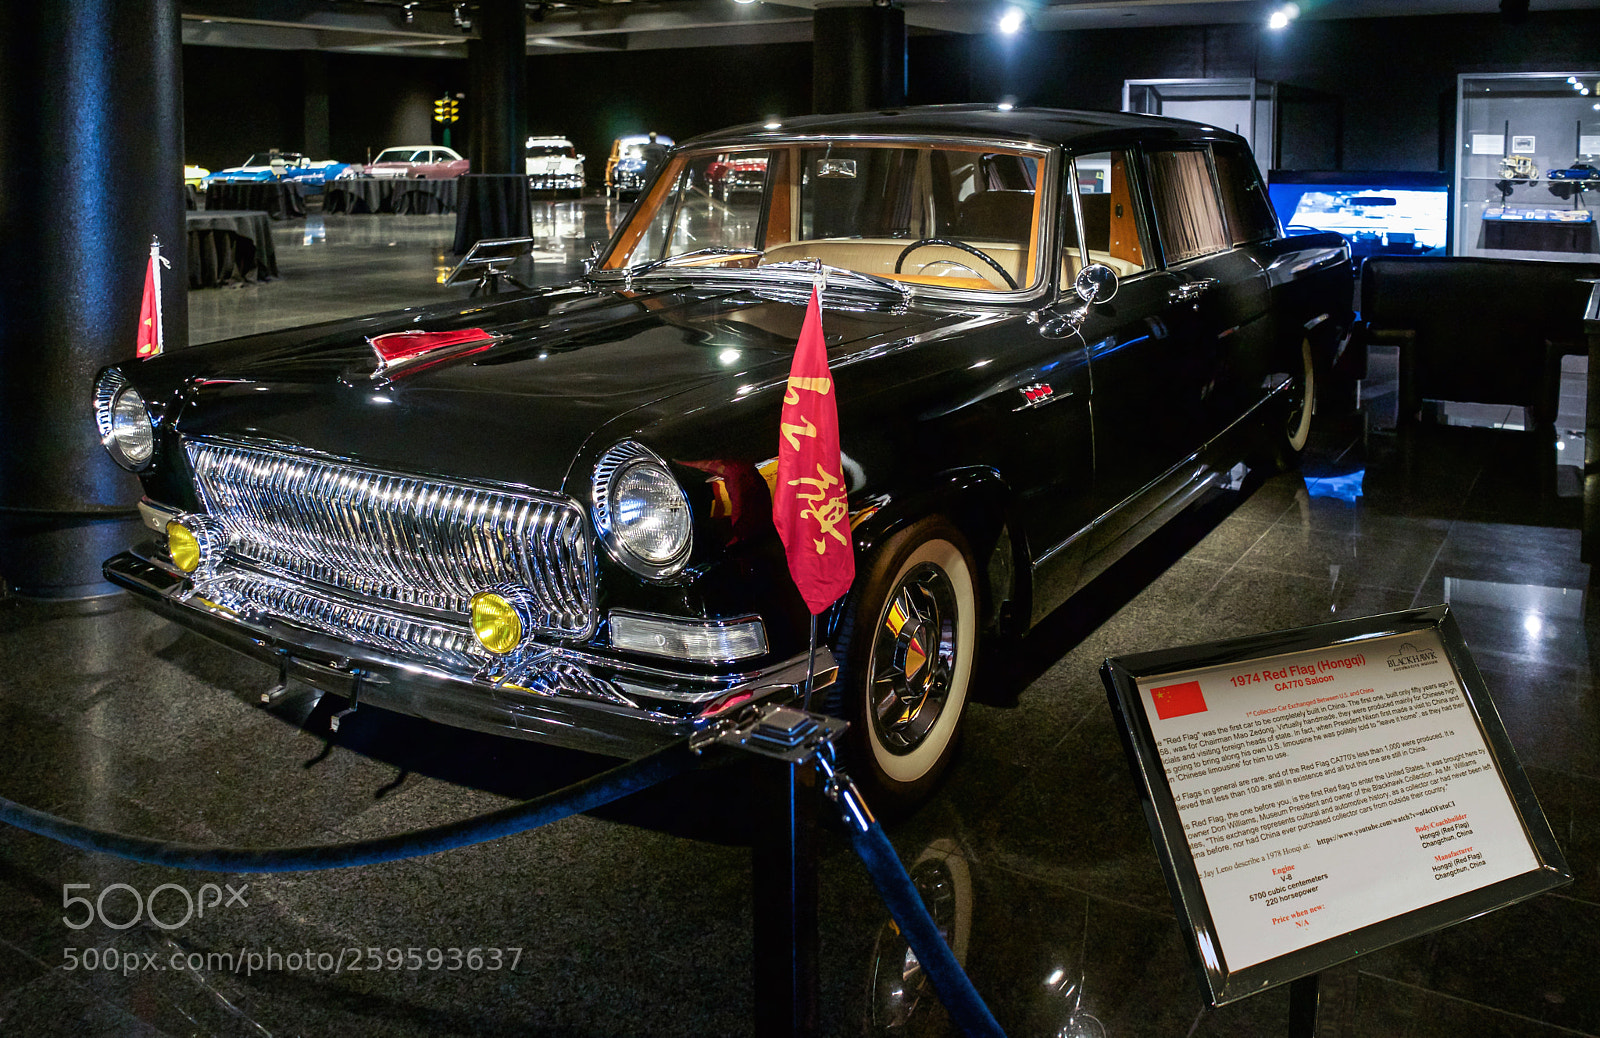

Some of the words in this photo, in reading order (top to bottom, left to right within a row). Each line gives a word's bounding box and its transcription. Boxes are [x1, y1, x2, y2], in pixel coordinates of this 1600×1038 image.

[1387, 652, 1437, 667] BLACKHAWK
[1231, 673, 1260, 686] 1974
[1263, 668, 1287, 680] Red
[1289, 666, 1315, 676] Flag
[1318, 654, 1365, 672] (Hongqi)
[1275, 680, 1303, 691] CA770
[1305, 676, 1334, 685] Saloon
[1253, 708, 1277, 716] Collector
[1288, 699, 1316, 709] Exchanged
[1273, 711, 1305, 722] completely
[1199, 736, 1232, 747] Chairman
[1276, 720, 1302, 730] Virtually
[1173, 764, 1193, 774] going
[1202, 758, 1220, 766] bring
[1221, 753, 1240, 761] along
[1283, 737, 1312, 747] limousine
[1336, 727, 1357, 737] politely
[1182, 752, 1196, 760] and
[1197, 748, 1221, 757] visiting
[1222, 743, 1245, 752] foreign
[1246, 738, 1266, 746] heads
[1182, 791, 1202, 800] Flags
[1212, 781, 1237, 794] general
[1268, 771, 1281, 779] and
[1301, 763, 1314, 771] Red
[1330, 754, 1356, 764] CA770's
[1200, 797, 1214, 806] that
[1230, 790, 1246, 798] than
[1247, 786, 1260, 794] 100
[1274, 780, 1285, 788] still
[1293, 772, 1323, 783] existence
[1324, 767, 1336, 775] and
[1191, 819, 1207, 828] Red
[1254, 803, 1276, 812] before
[1324, 786, 1337, 794] Red
[1358, 777, 1373, 785] enter
[1188, 829, 1209, 839] owner
[1211, 825, 1226, 833] Don
[1259, 809, 1288, 820] Museum
[1289, 800, 1320, 812] President
[1321, 796, 1333, 805] and
[1334, 792, 1353, 801] owner
[1226, 827, 1259, 840] exchange
[1260, 817, 1295, 830] represents
[1297, 809, 1320, 821] cultural
[1321, 806, 1333, 814] and
[1335, 798, 1368, 811] automotive
[1245, 835, 1259, 844] had
[1260, 831, 1280, 840] China
[1282, 827, 1296, 835] ever
[1298, 816, 1331, 832] purchased
[1332, 810, 1358, 821] collector
[1419, 830, 1440, 840] Hongqi
[1441, 826, 1454, 835] (Red
[1455, 821, 1469, 830] Flag)
[1422, 836, 1456, 848] Changchun,
[1456, 830, 1473, 838] China
[1216, 866, 1233, 874] Leno
[1234, 858, 1260, 869] describe
[1266, 850, 1282, 860] 1978
[1432, 861, 1453, 872] Hongqi
[1454, 856, 1467, 866] (Red
[1467, 852, 1482, 860] Flag)
[1435, 847, 1472, 862] Manufacturer
[1272, 865, 1295, 875] Engine
[1280, 874, 1292, 882] V-8
[1435, 866, 1469, 880] Changchun,
[1469, 860, 1486, 869] China
[1250, 891, 1266, 901] 5700
[1268, 887, 1286, 896] cubic
[1288, 874, 1328, 890] centemeters
[1266, 897, 1278, 906] 220
[1279, 886, 1318, 902] horsepower
[1272, 916, 1289, 925] Price
[1291, 910, 1308, 918] when
[1310, 905, 1325, 913] new:
[1295, 920, 1309, 928] N/A
